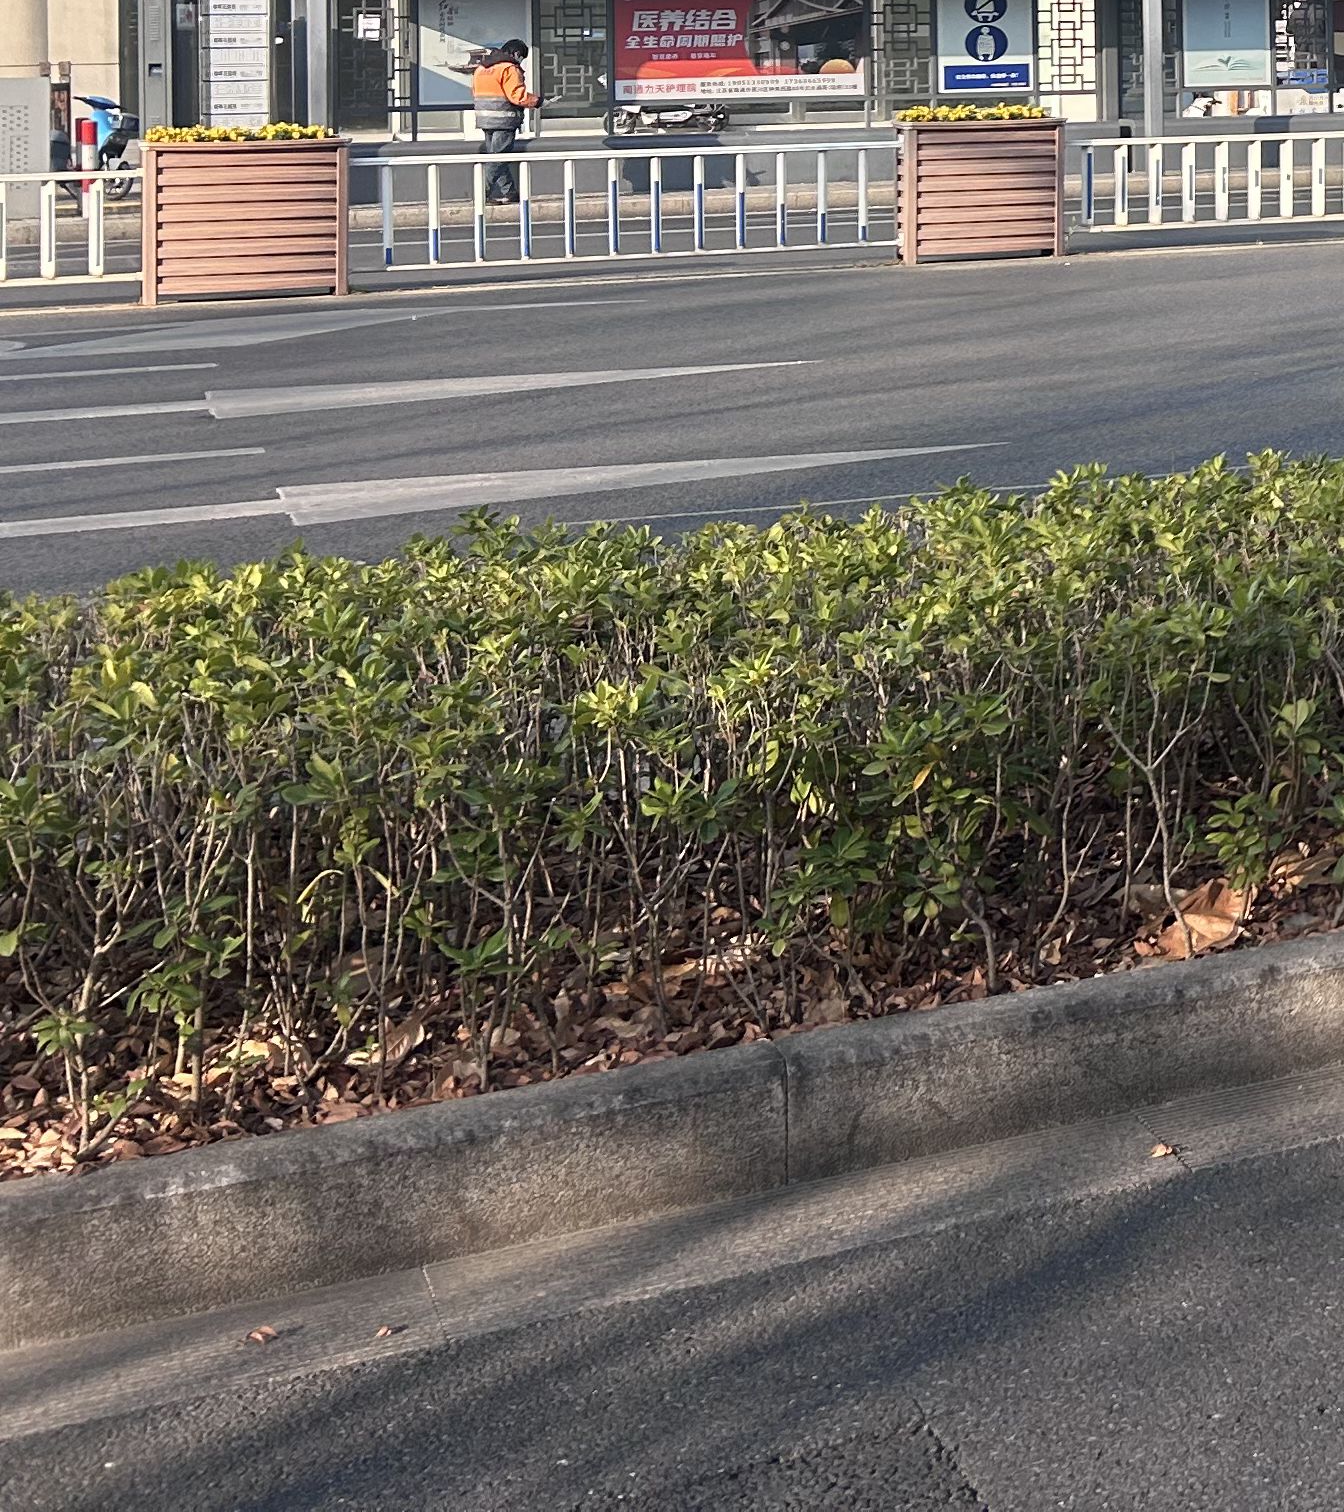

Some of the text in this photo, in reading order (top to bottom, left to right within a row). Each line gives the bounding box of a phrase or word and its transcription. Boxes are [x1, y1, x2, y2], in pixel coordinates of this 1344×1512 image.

[632, 9, 737, 31] 医养结合
[624, 34, 743, 49] 全生命周期照护
